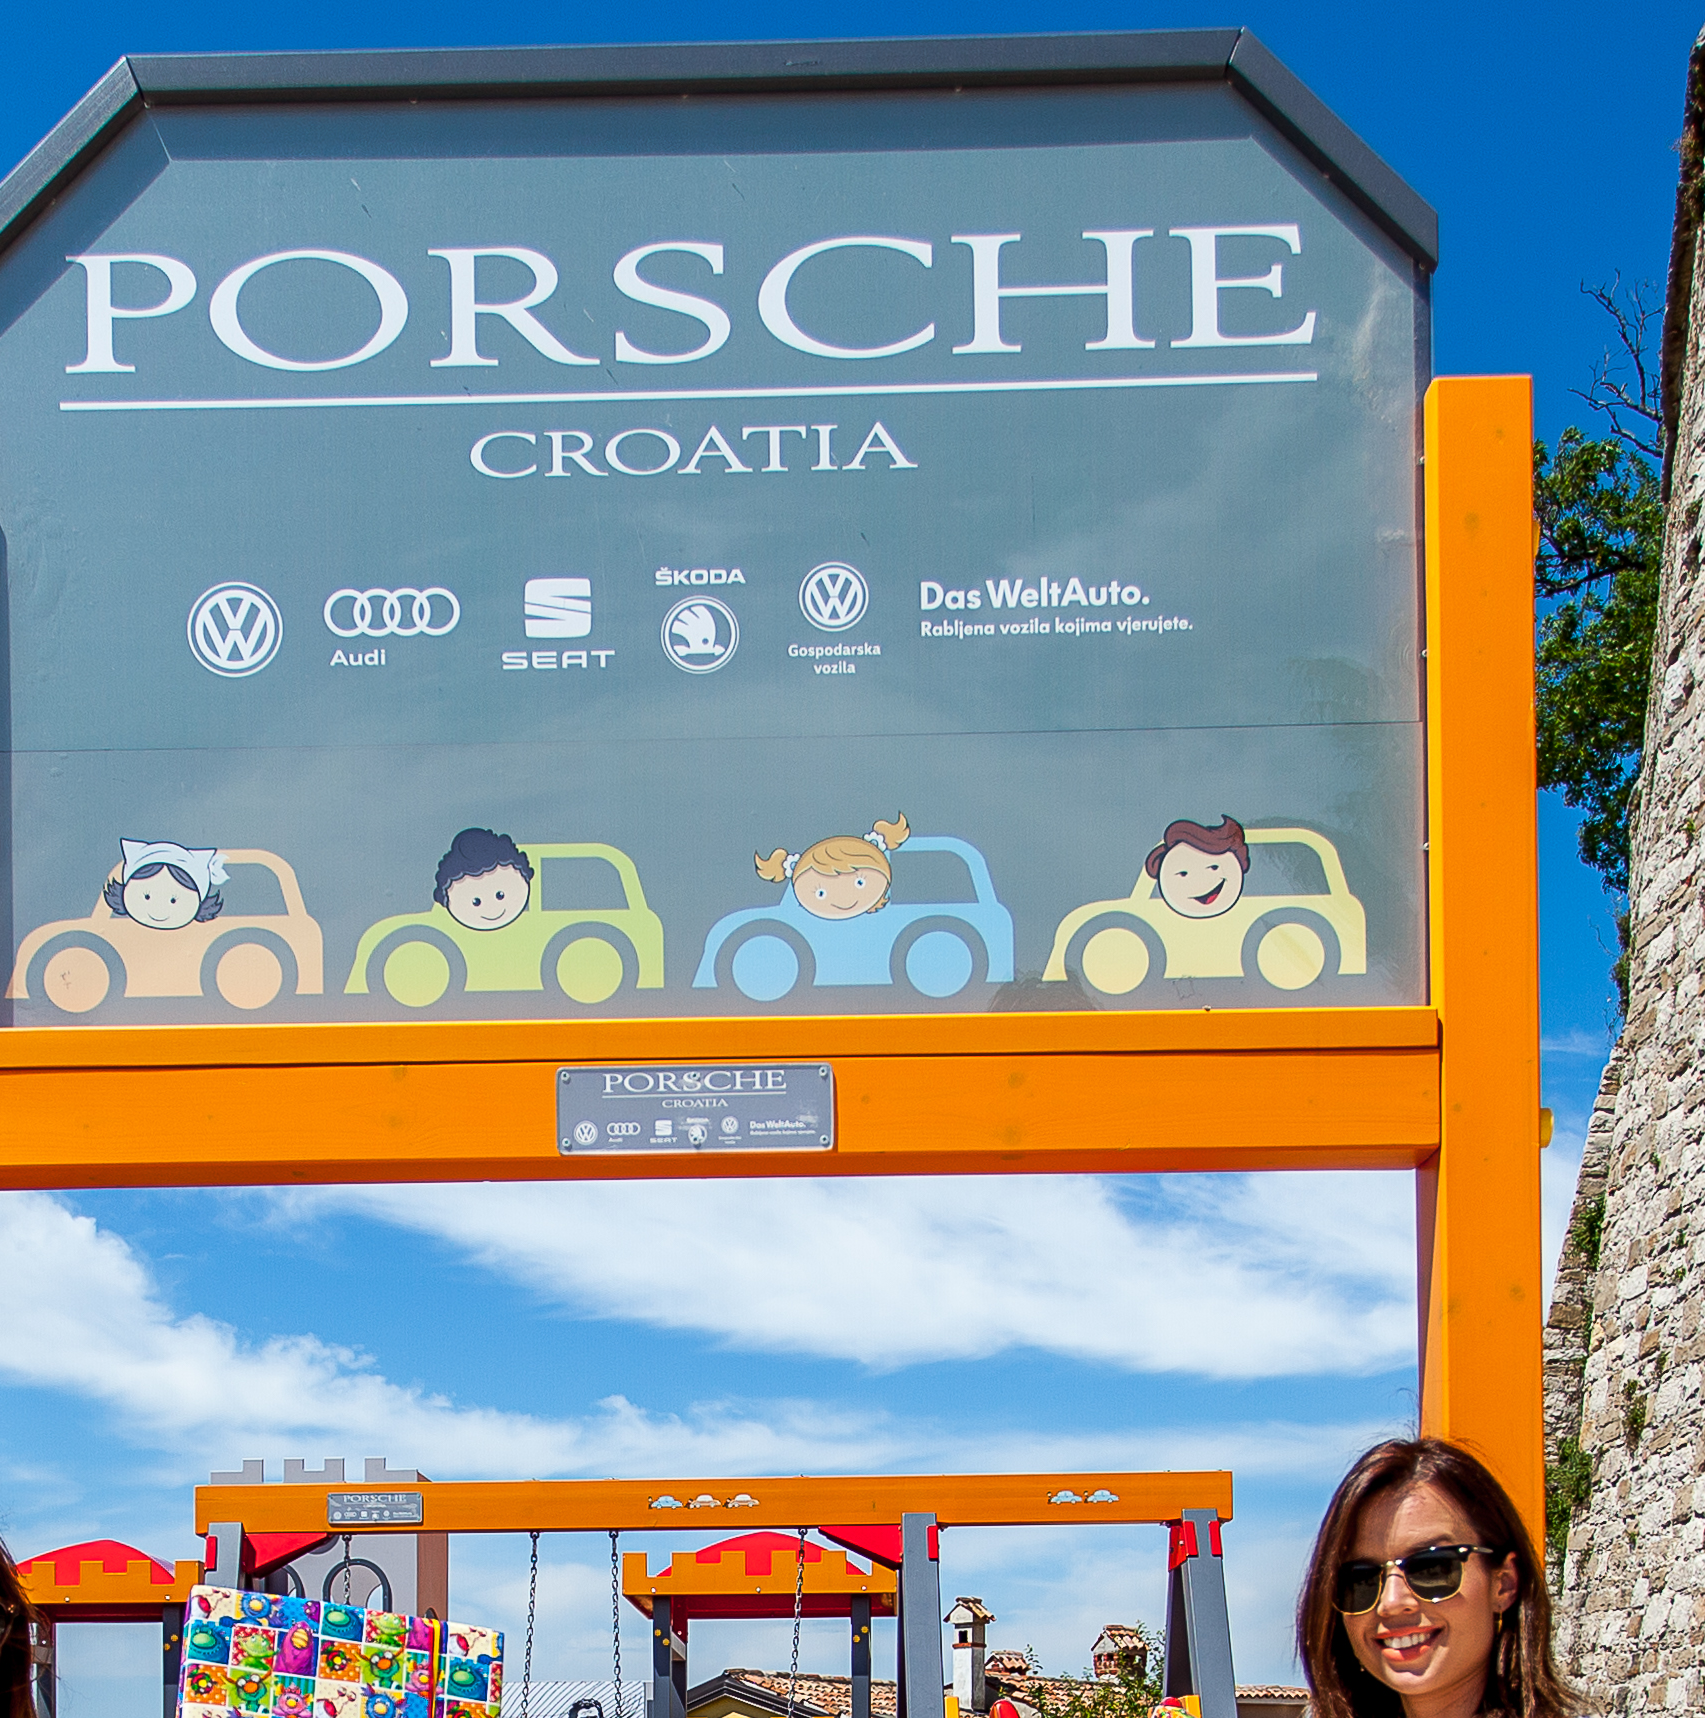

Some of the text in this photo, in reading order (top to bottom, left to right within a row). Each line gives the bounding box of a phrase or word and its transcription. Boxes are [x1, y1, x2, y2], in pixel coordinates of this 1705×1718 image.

[64, 225, 1317, 375] PORSCHE
[469, 421, 919, 478] CROATIA
[655, 567, 746, 586] ŠKODA
[920, 576, 1150, 611] Das WeltAuto.
[920, 615, 1193, 640] Rabljena vozila kojima vjerujete.
[329, 648, 386, 667] Audi
[501, 650, 616, 670] SEAT
[787, 642, 881, 660] Gospodarska
[813, 660, 856, 675] vozila
[602, 1070, 787, 1093] PORSCHE
[661, 1098, 729, 1108] CROATIA
